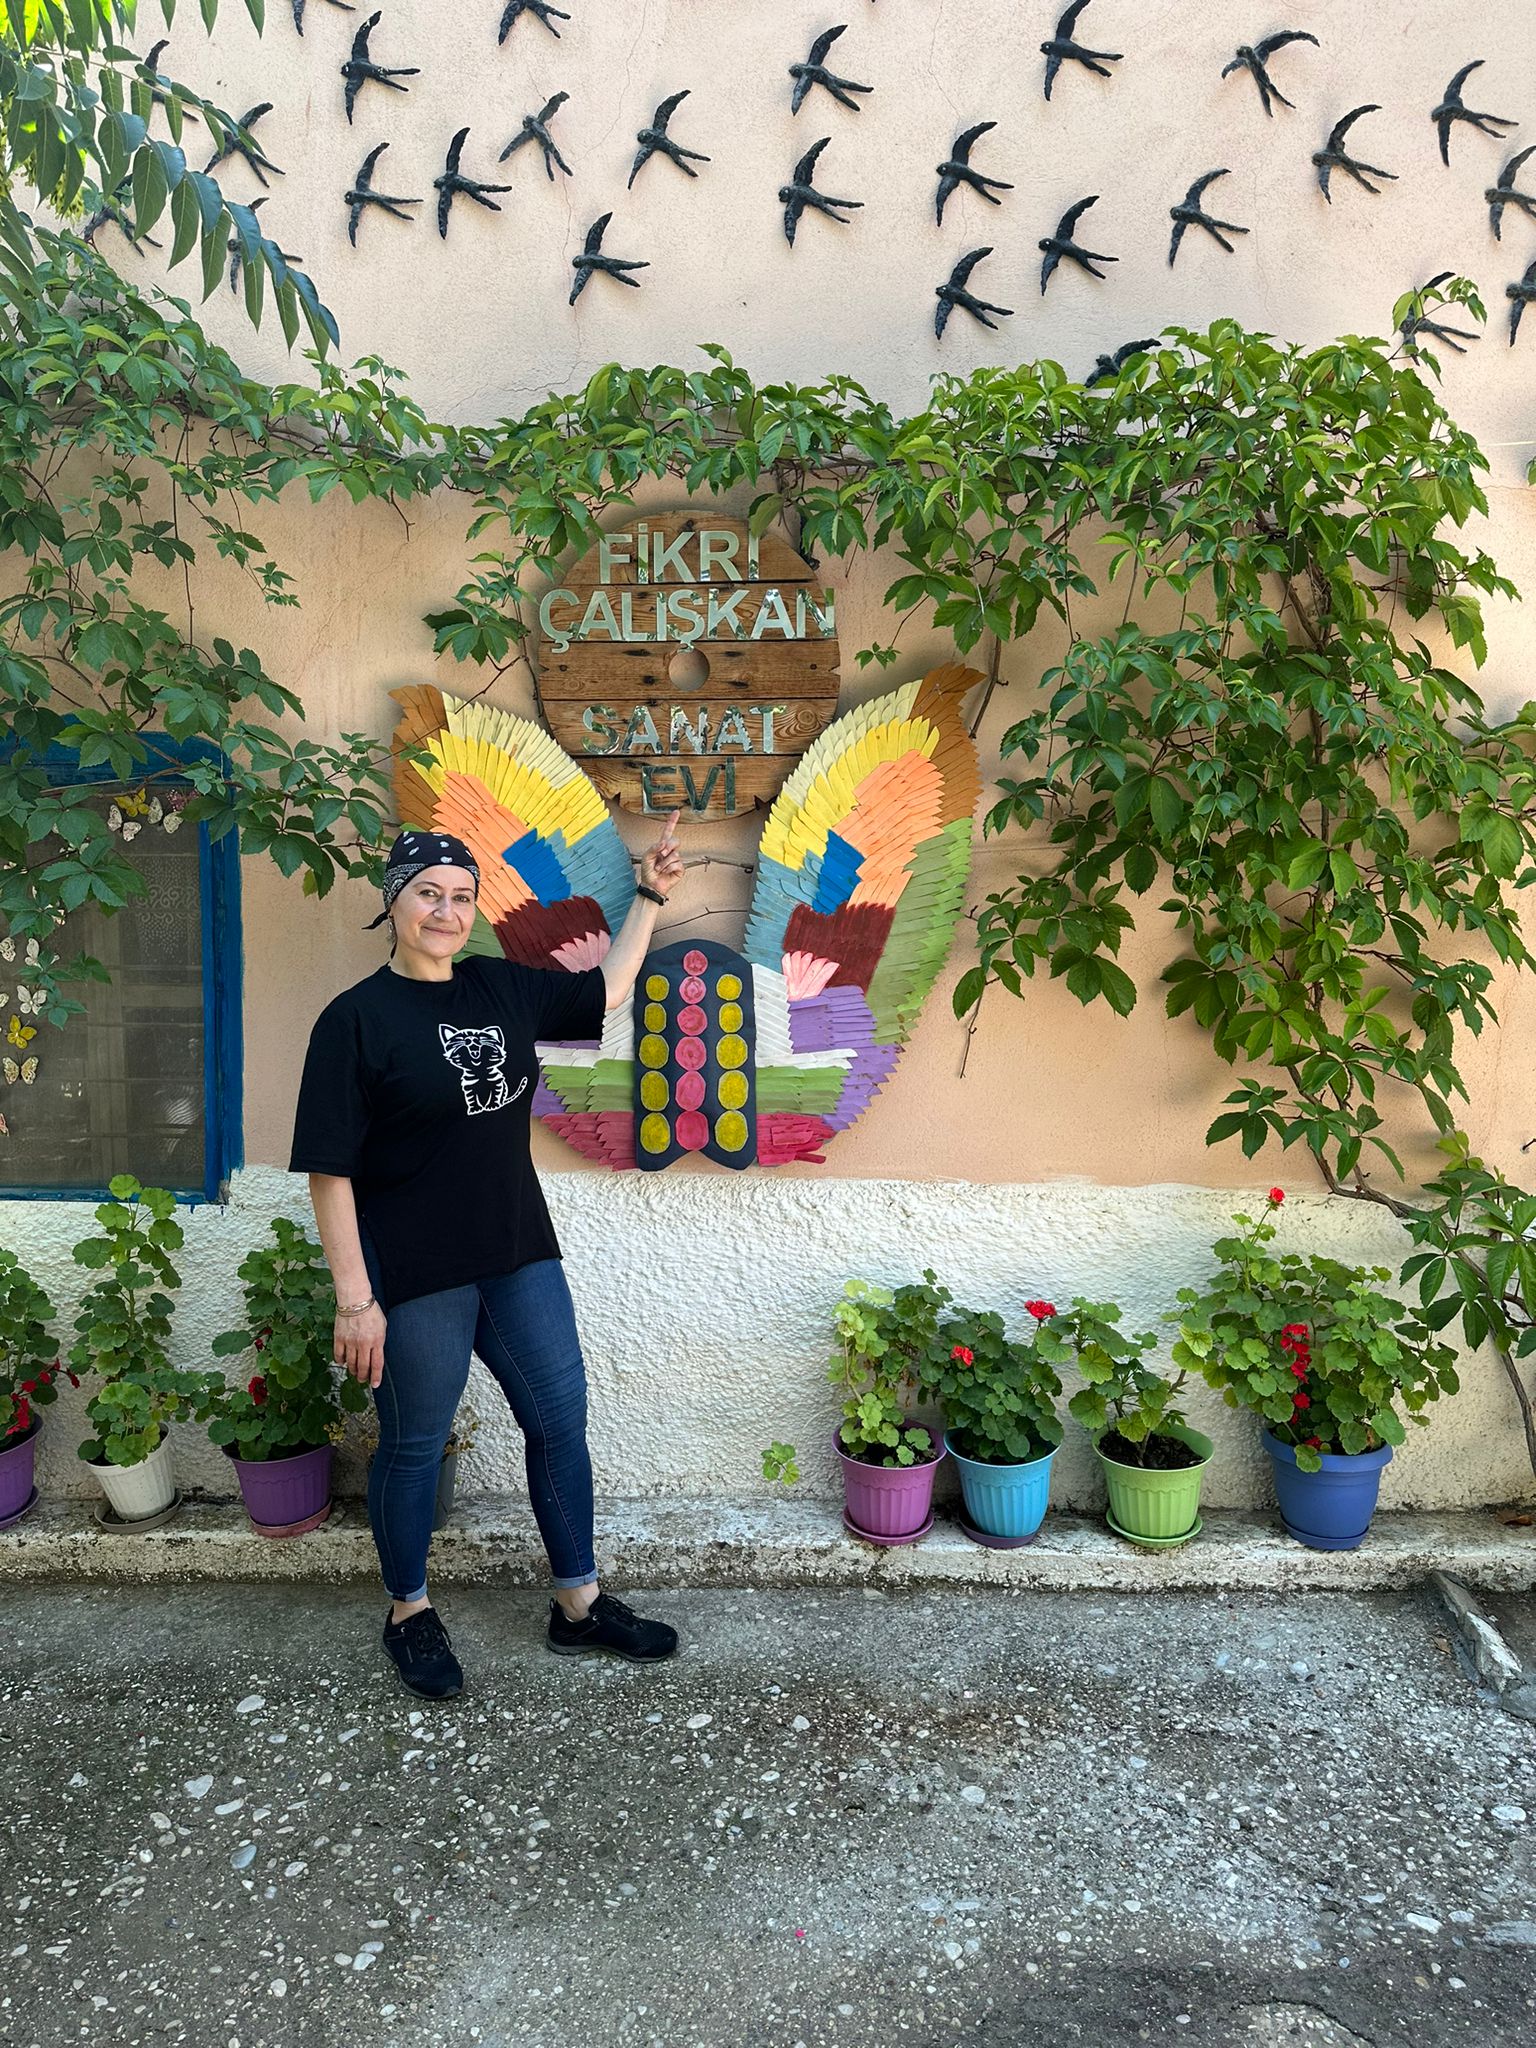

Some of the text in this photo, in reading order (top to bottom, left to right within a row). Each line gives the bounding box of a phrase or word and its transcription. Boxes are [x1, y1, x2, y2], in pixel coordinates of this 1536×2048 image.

[539, 588, 835, 653] ÇALIŞKAN
[582, 705, 787, 755] SANAT
[641, 757, 736, 815] EVİ
